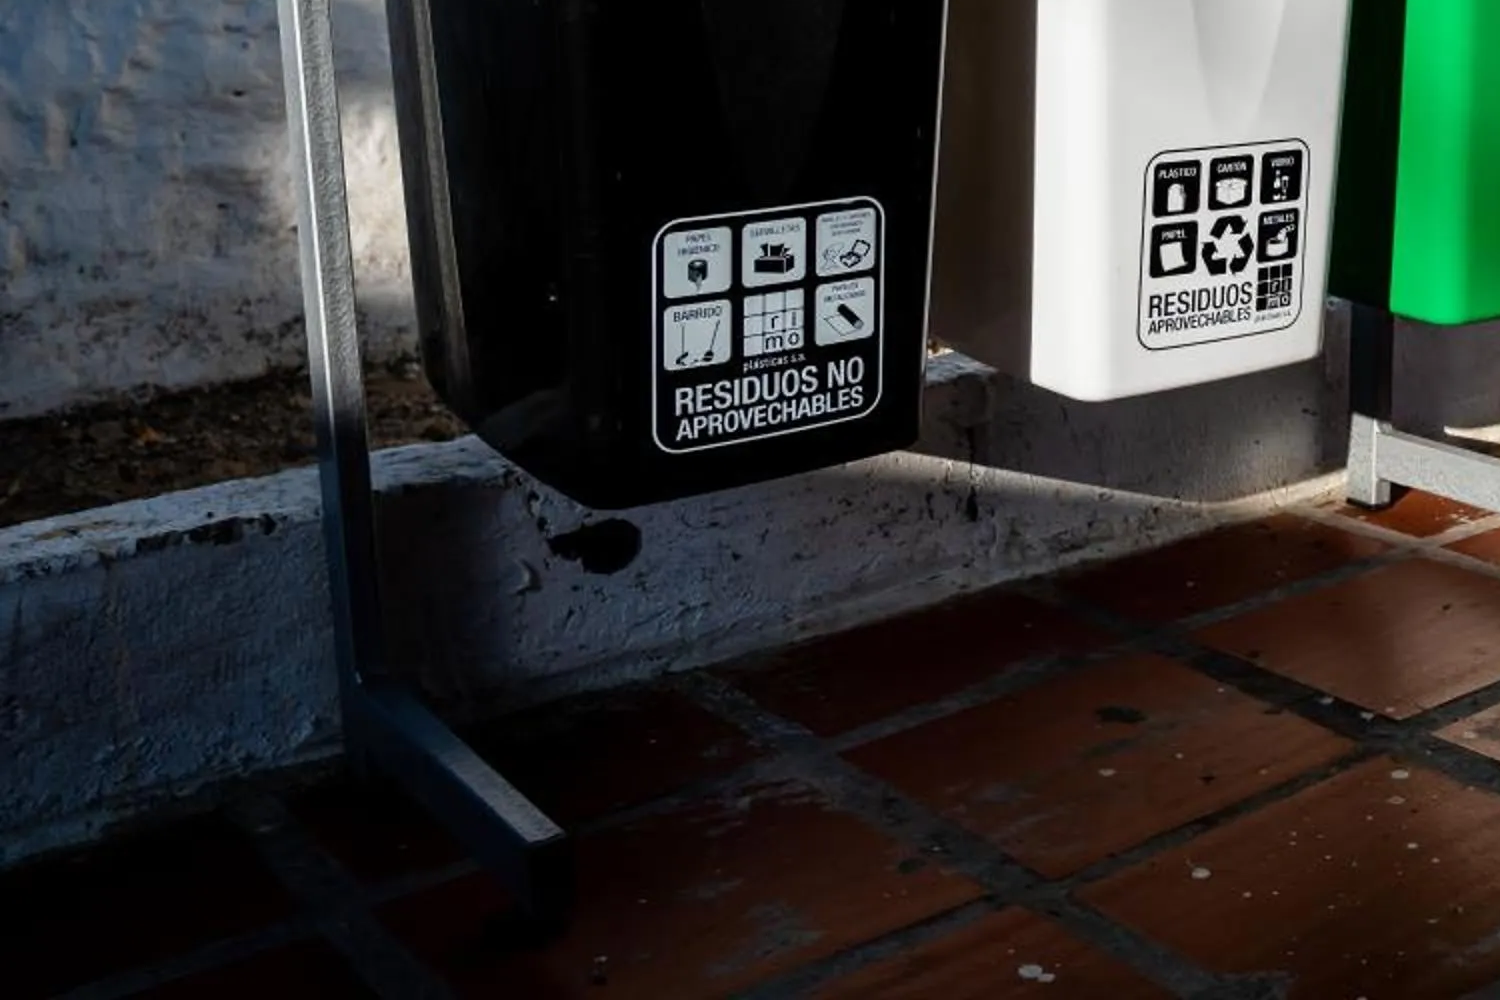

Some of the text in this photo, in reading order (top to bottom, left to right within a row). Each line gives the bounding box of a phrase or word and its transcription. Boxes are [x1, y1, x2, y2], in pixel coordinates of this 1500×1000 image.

[673, 305, 723, 323] BARRIDO
[1149, 281, 1253, 319] RESIDUOS
[1148, 306, 1251, 335] APROVECHABLES
[674, 356, 865, 417] RESIDUOS NO
[675, 385, 864, 442] APROVECHABLES
